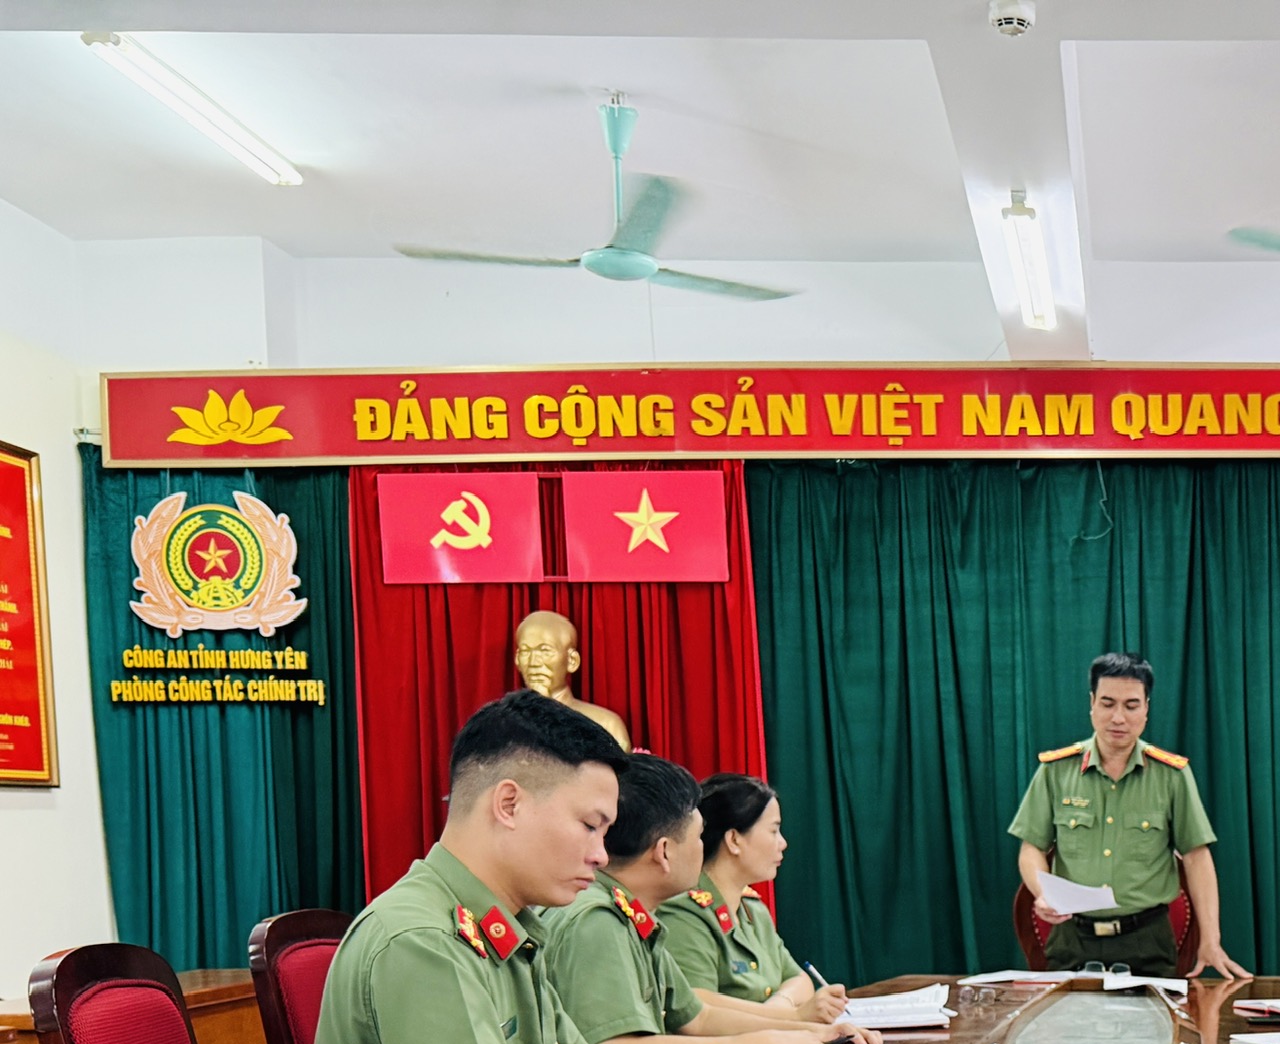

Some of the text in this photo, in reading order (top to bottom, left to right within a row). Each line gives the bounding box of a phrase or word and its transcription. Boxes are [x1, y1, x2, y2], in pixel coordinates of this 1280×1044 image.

[353, 380, 508, 441] ĐẢNG
[523, 385, 674, 446] CỘNG
[691, 376, 806, 437] SẢN
[824, 383, 943, 446] VIỆT
[962, 394, 1094, 437] NAM
[123, 643, 307, 670] CÔNG AN TỈNH HƯNG YÊN
[111, 674, 325, 706] PHÒNG CÔNG TÁC CHÍNH TRỊ
